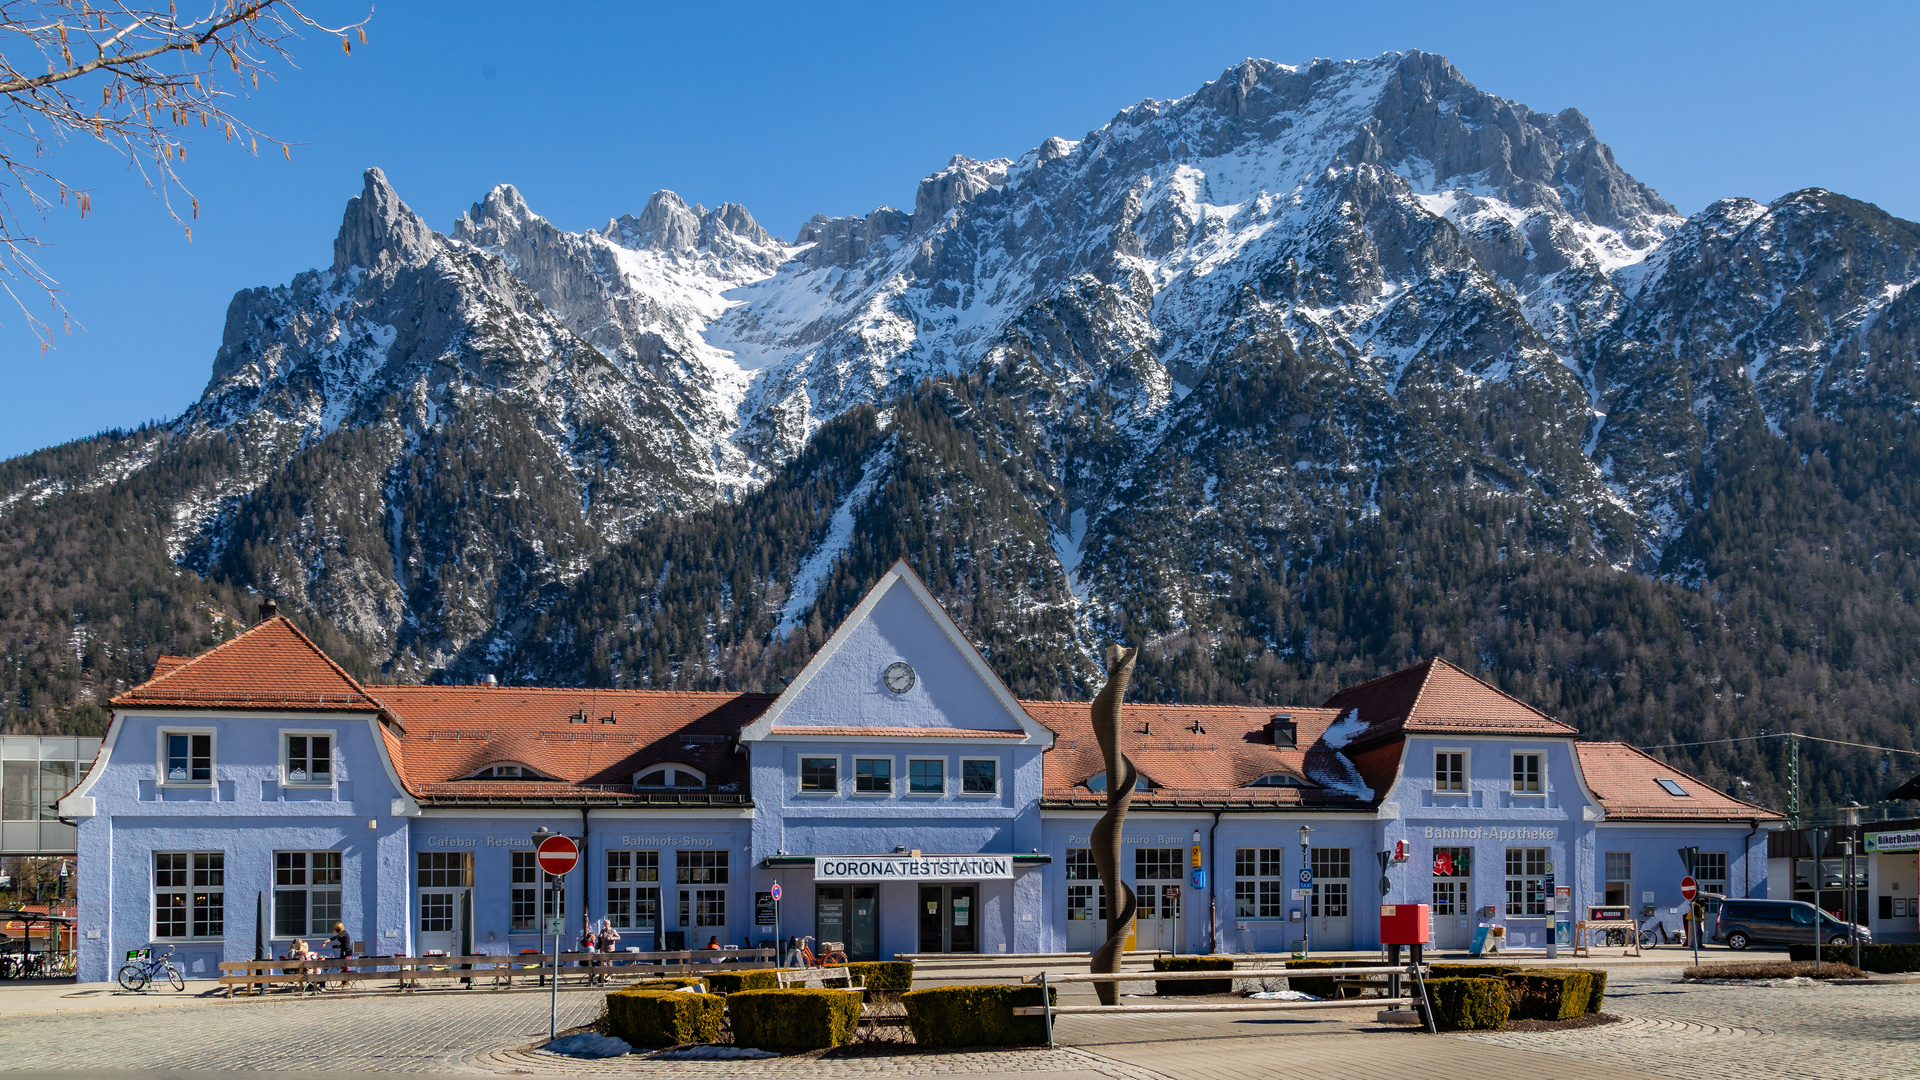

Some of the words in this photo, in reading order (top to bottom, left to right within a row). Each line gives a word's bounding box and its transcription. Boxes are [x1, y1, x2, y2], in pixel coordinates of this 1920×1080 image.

[1121, 834, 1150, 844] ebüro
[1158, 834, 1183, 844] Bahn
[1424, 826, 1555, 843] Bahnhof-Apotheke
[428, 836, 478, 847] Cafébar
[487, 836, 534, 847] Restaur
[622, 835, 714, 848] Bahnhofs-Shop
[823, 862, 896, 876] CORONA
[900, 861, 1007, 876] TESTSTATION
